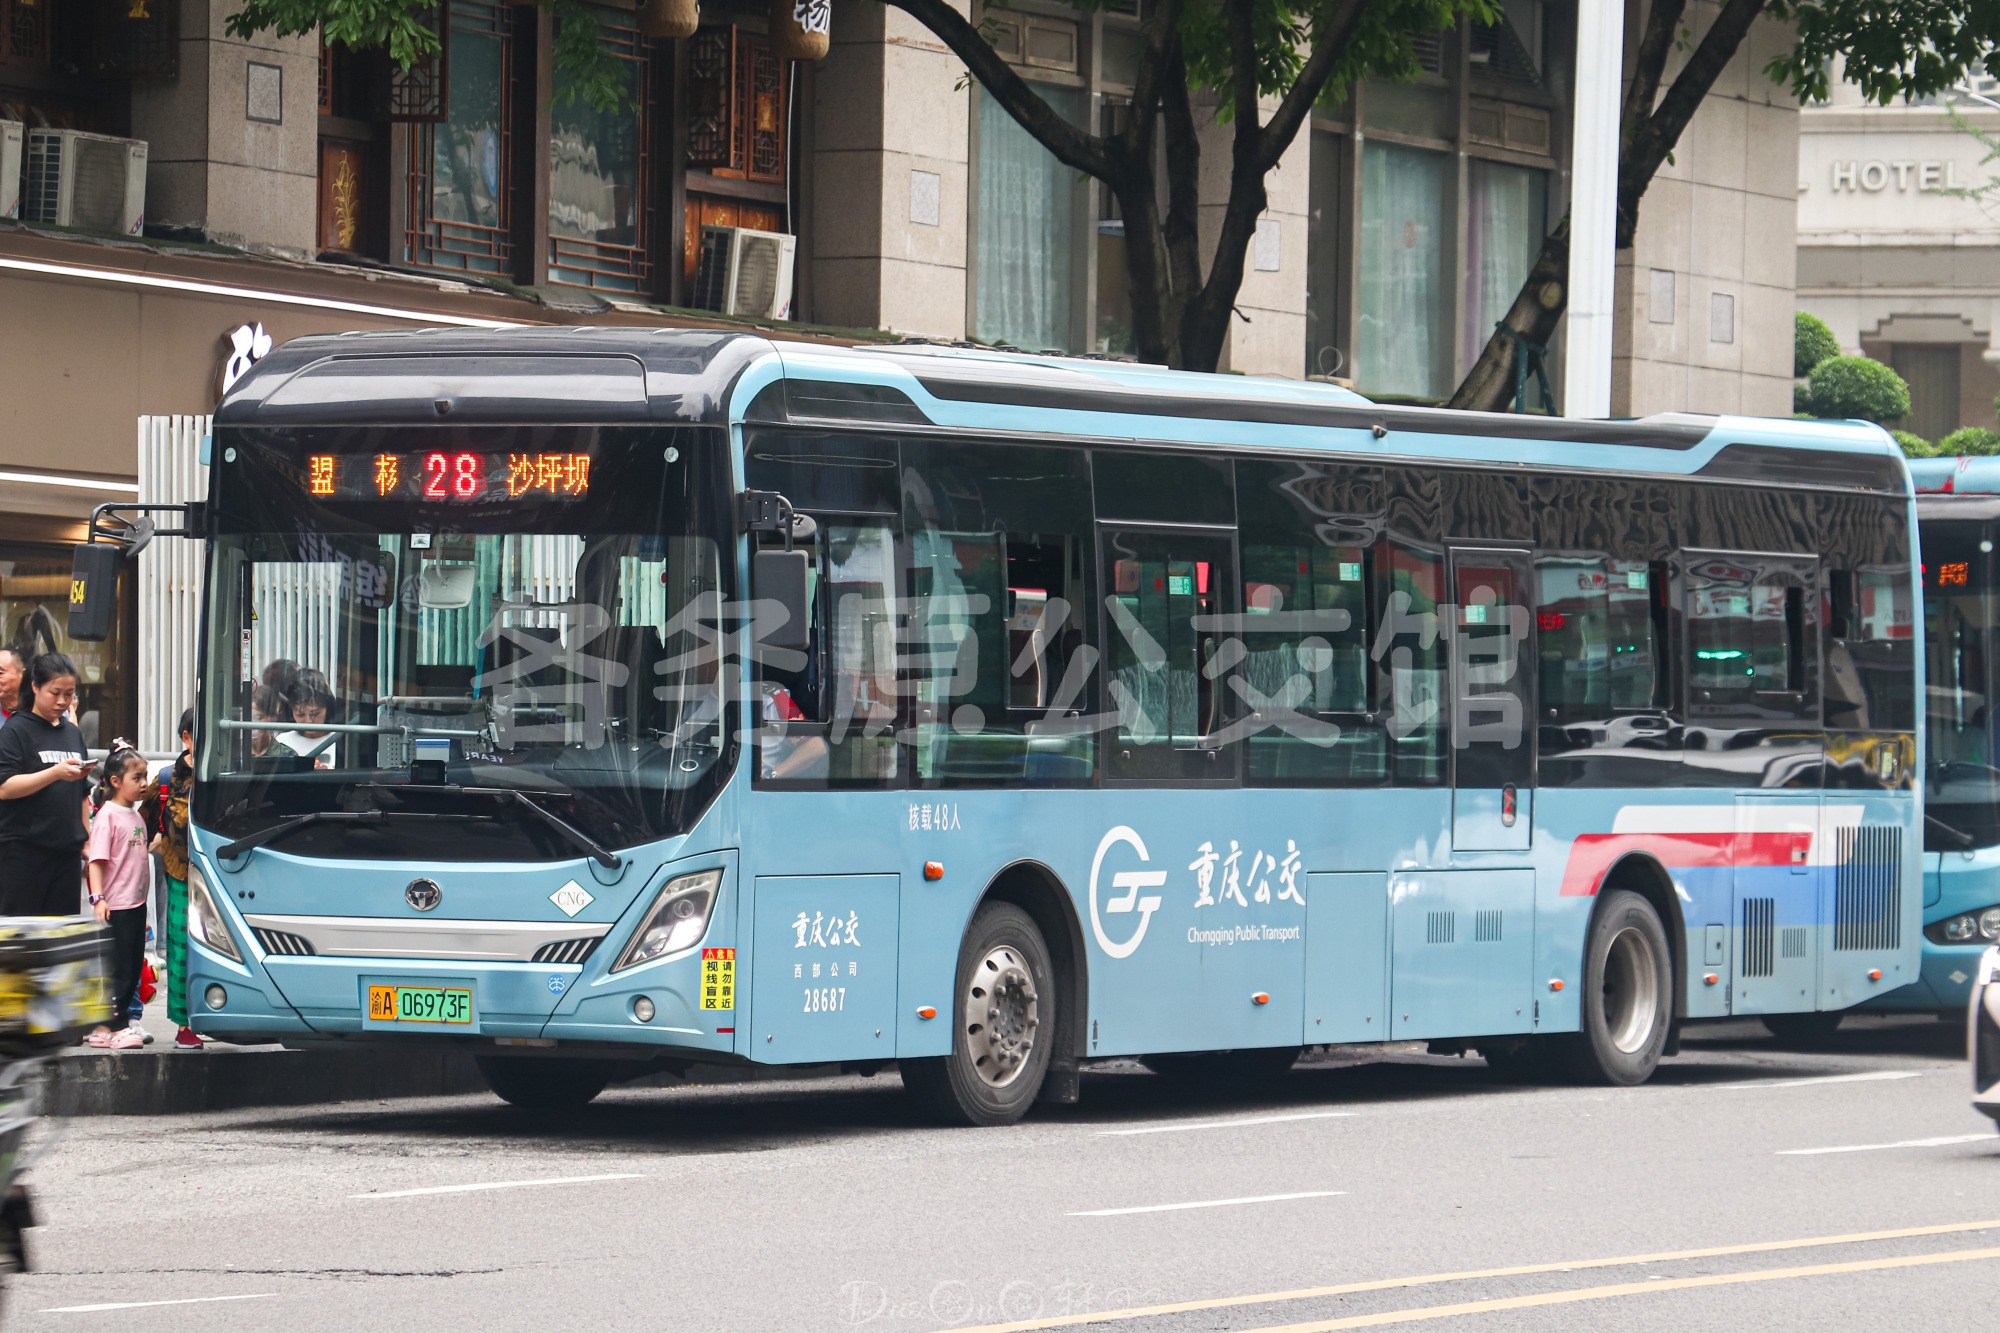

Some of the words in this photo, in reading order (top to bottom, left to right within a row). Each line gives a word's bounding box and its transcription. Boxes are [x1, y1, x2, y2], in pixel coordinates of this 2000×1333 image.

[1833, 160, 1966, 192] HOTEL
[428, 454, 476, 496] 28
[508, 454, 590, 496] 沙坪坝
[908, 803, 961, 832] 核载48人
[1188, 838, 1306, 909] 重庆公交
[557, 891, 586, 906] CNG
[792, 910, 861, 949] 重庆公交
[1188, 926, 1234, 946] Chongqing
[1235, 925, 1260, 941] Public
[1261, 924, 1300, 943] Transport
[705, 960, 718, 1008] 视线盲区
[721, 960, 732, 1008] 请勿靠近
[794, 961, 857, 979] 西部公司
[803, 987, 846, 1013] 28687
